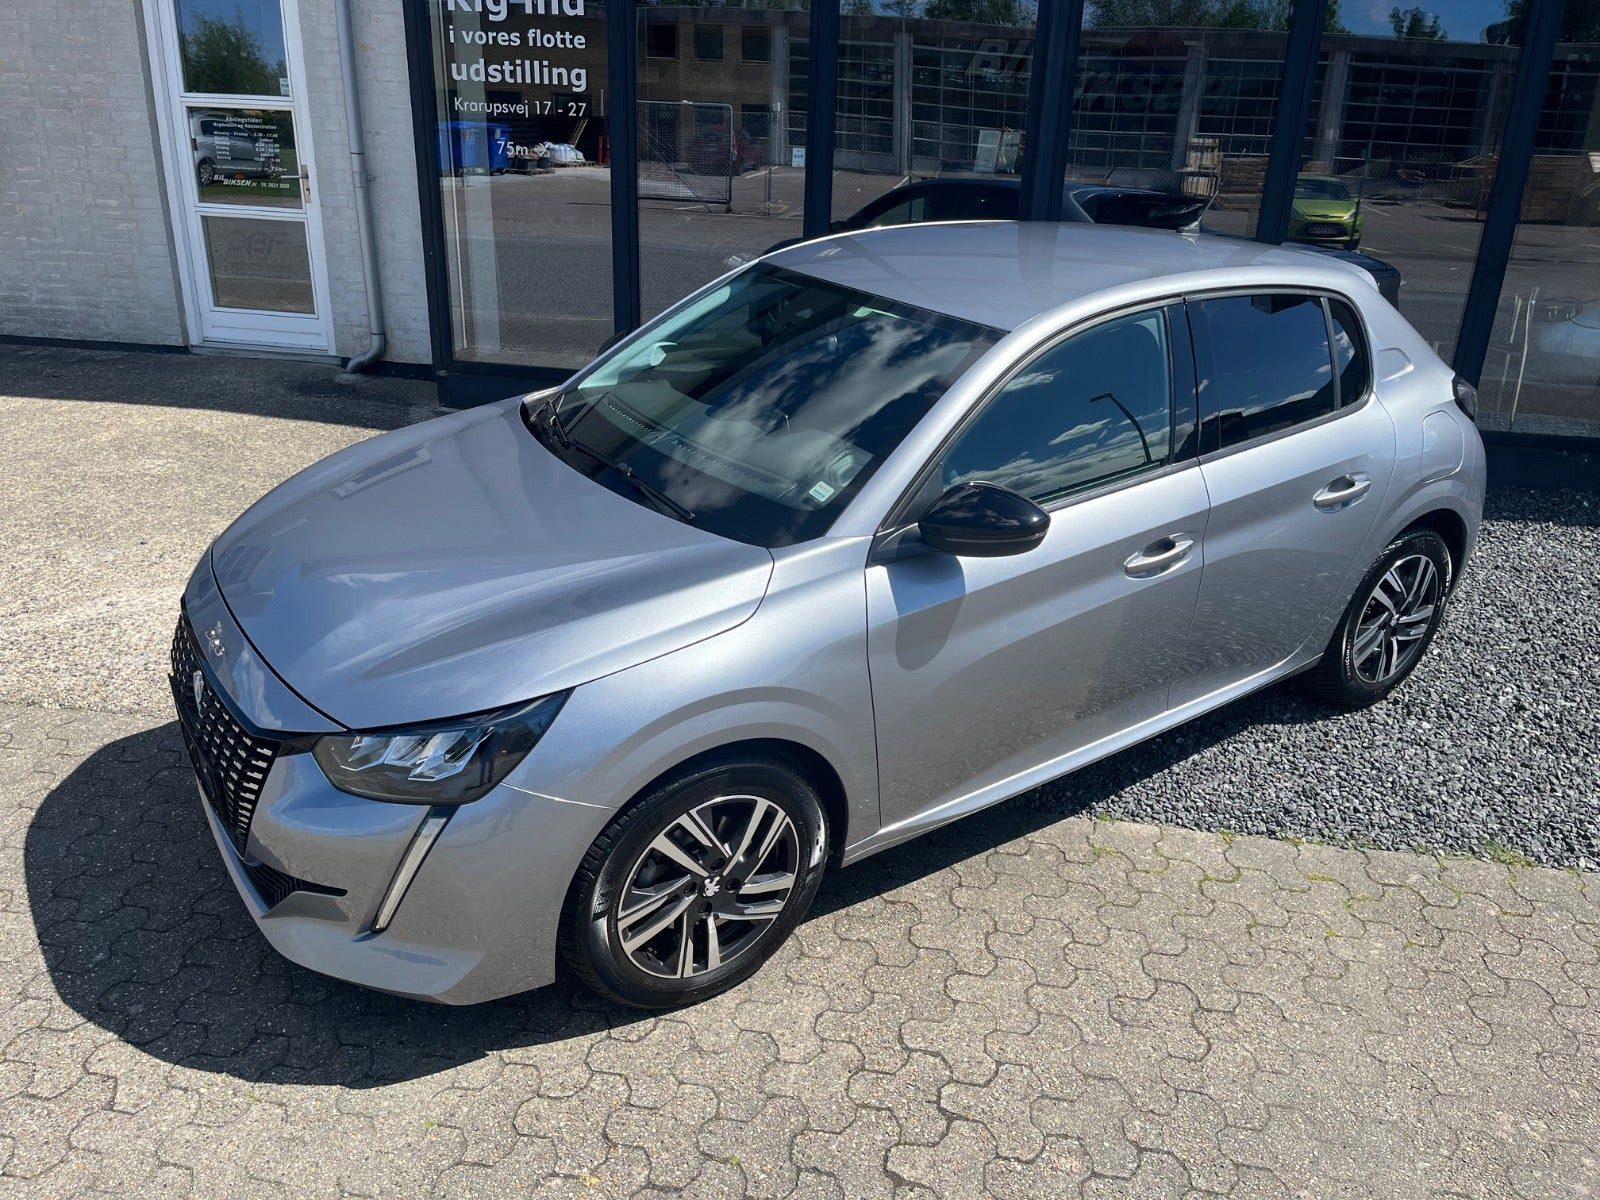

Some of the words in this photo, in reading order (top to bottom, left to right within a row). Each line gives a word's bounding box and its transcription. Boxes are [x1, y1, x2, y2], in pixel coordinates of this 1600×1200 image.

[449, 25, 455, 43] i
[462, 30, 521, 46] vores
[527, 28, 586, 49] flotte
[451, 58, 587, 93] udstilling
[454, 97, 529, 118] Krarupsvej
[535, 100, 552, 115] 17
[568, 102, 587, 117] 27
[497, 141, 529, 156] 75m
